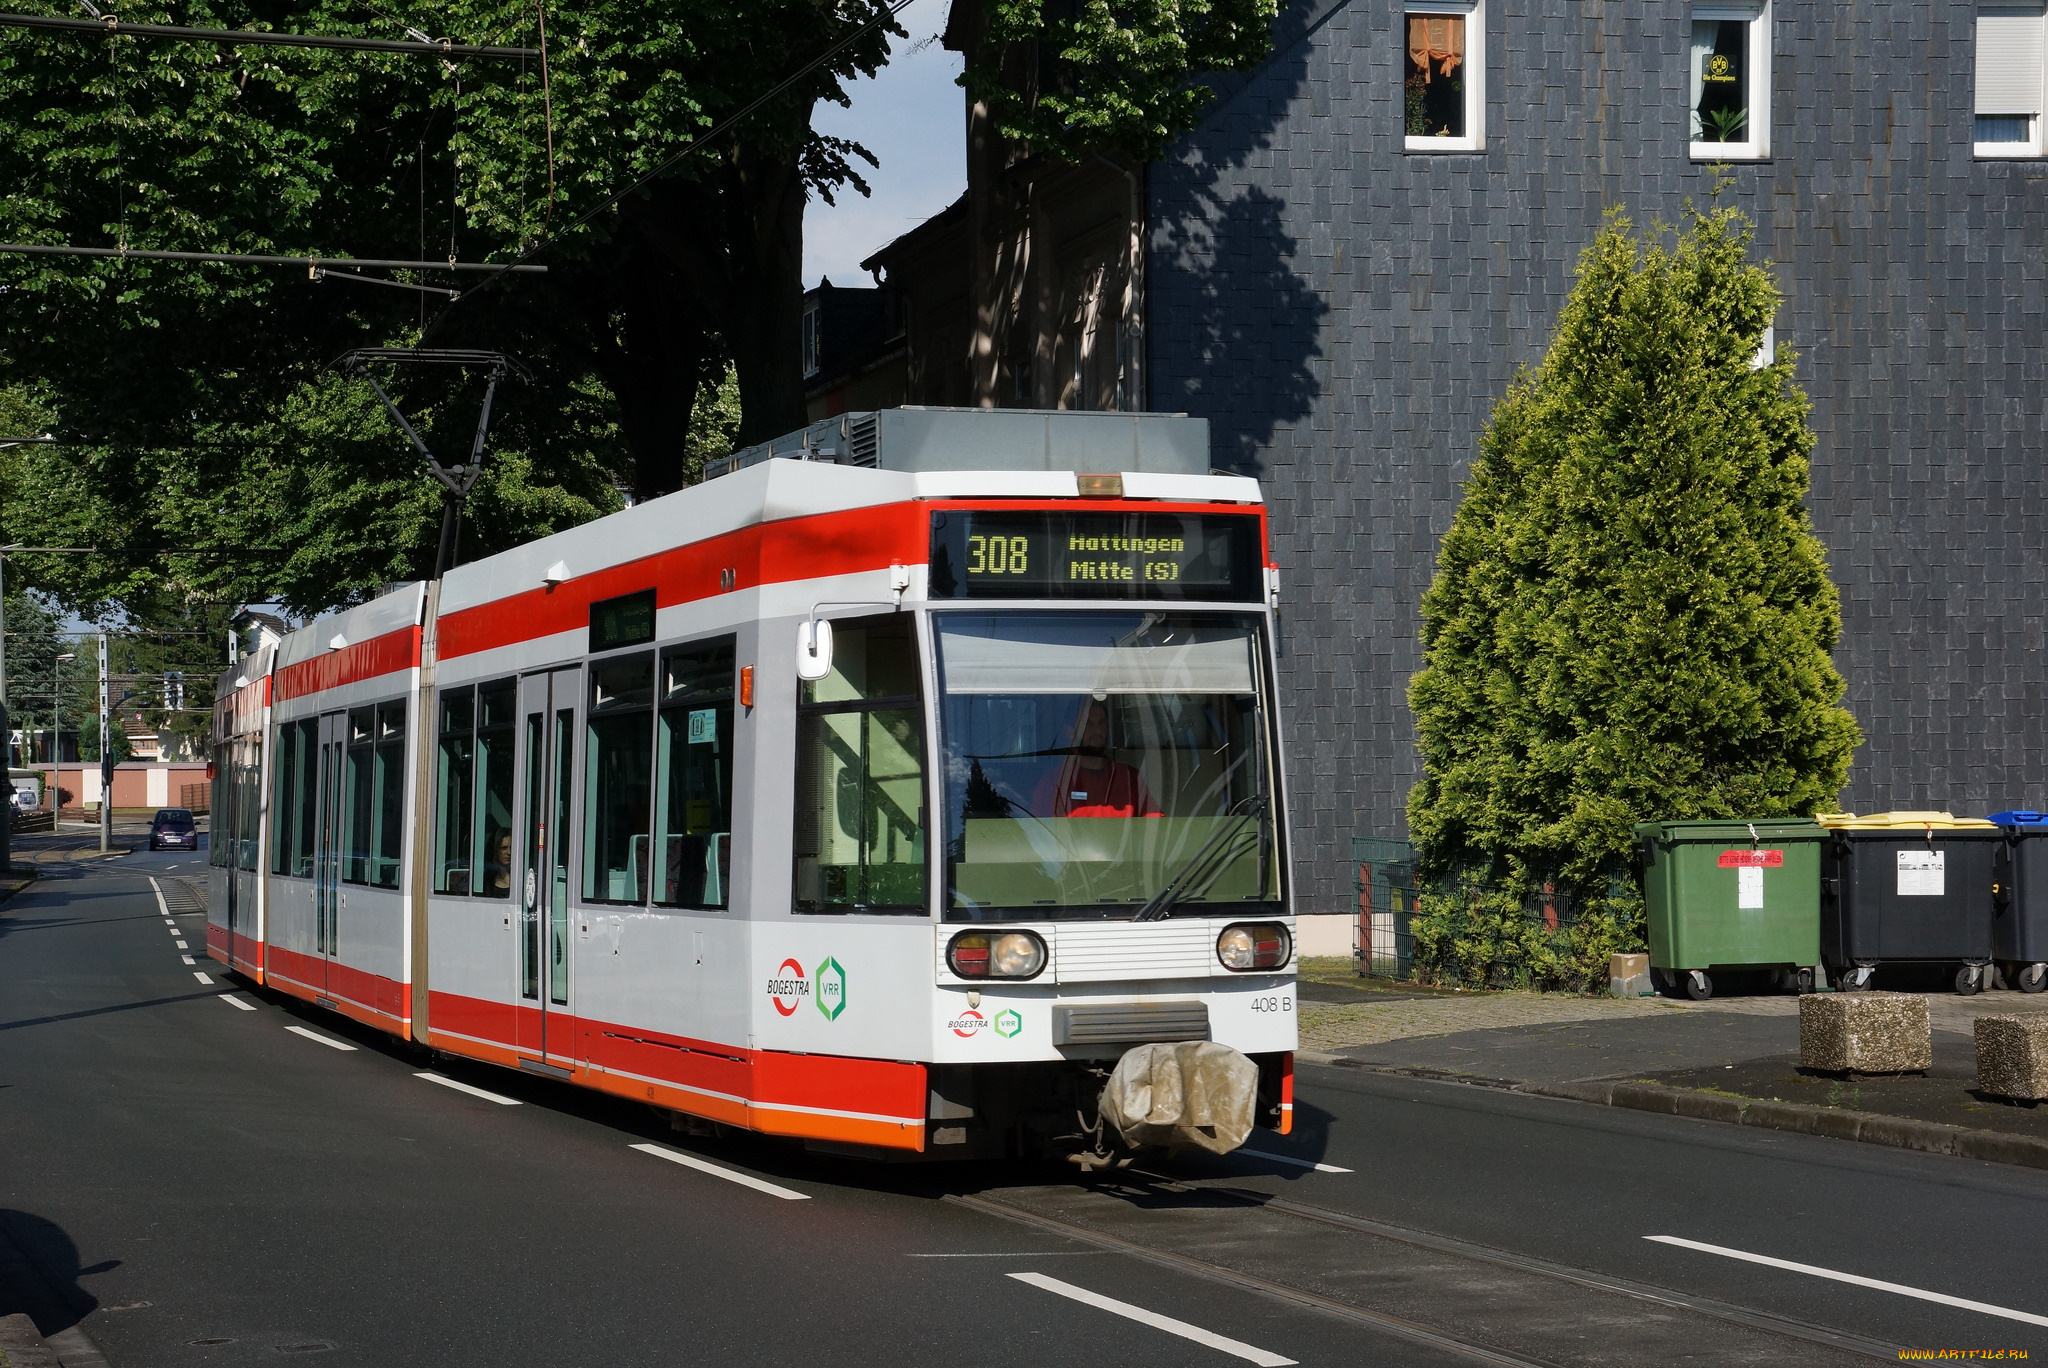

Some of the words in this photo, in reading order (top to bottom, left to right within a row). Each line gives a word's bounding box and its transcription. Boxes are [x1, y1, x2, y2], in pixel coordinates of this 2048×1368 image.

[1712, 57, 1726, 69] BVB
[1069, 533, 1184, 553] Hattingen
[967, 535, 1028, 574] 308
[1070, 561, 1134, 580] Mitte
[1145, 561, 1179, 580] (S)
[767, 979, 810, 996] BOGESTRA
[822, 983, 839, 995] VRR
[1251, 997, 1278, 1012] 408
[1282, 997, 1292, 1011] B
[948, 1019, 989, 1029] BOGESTRA
